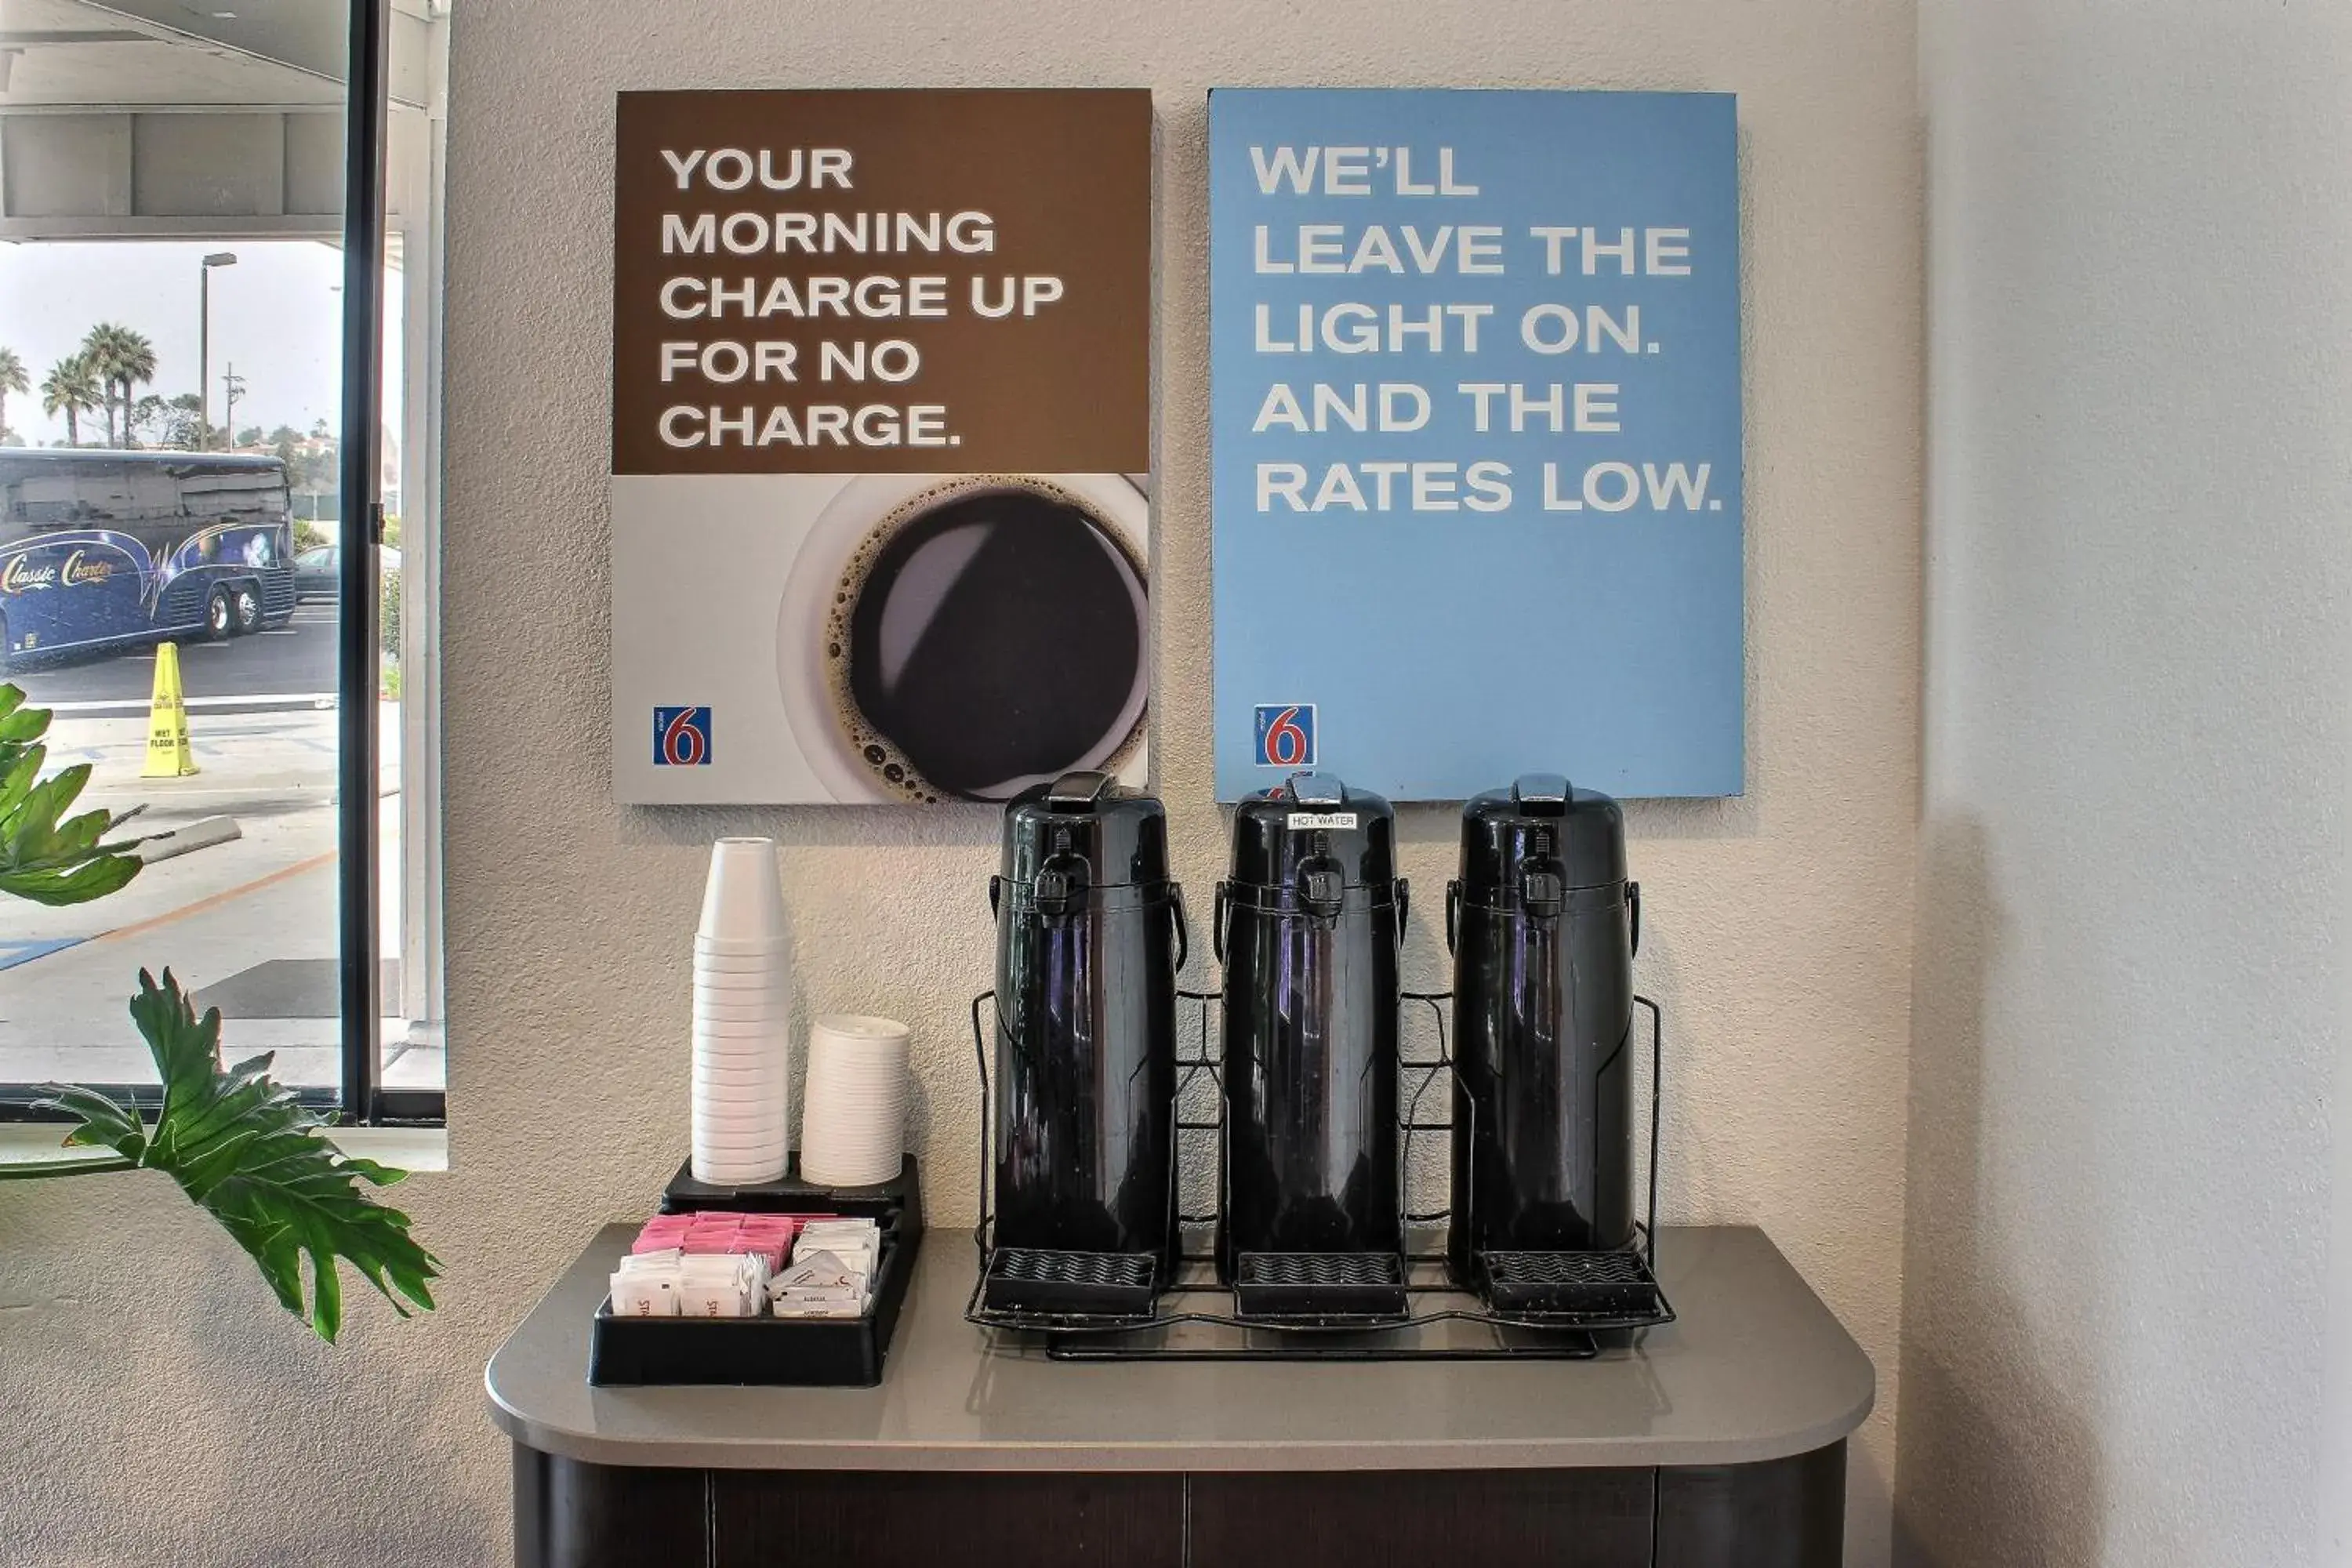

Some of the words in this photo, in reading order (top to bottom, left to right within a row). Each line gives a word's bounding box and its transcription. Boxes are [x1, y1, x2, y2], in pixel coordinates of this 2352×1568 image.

[660, 148, 854, 191] YOUR
[1250, 147, 1479, 195] WE’LL
[662, 211, 994, 255] MORNING
[1254, 225, 1504, 274] LEAVE
[1530, 227, 1691, 275] THE
[660, 275, 948, 319] CHARGE
[971, 277, 1064, 318] UP
[1255, 303, 1494, 354] LIGHT
[1520, 303, 1660, 354] ON.
[661, 340, 797, 383] FOR
[821, 339, 920, 382] NO
[659, 404, 960, 448] CHARGE.
[1251, 383, 1432, 433] AND
[1457, 383, 1621, 433] THE
[1256, 461, 1513, 512] RATES
[1543, 462, 1722, 512] LOW.
[2, 552, 55, 593] Classic
[150, 739, 175, 748] FLOOR
[154, 729, 170, 738] WET
[662, 707, 705, 766] 6
[1265, 706, 1306, 766] 6
[1293, 815, 1314, 826] HOT
[1318, 815, 1355, 826] WATER
